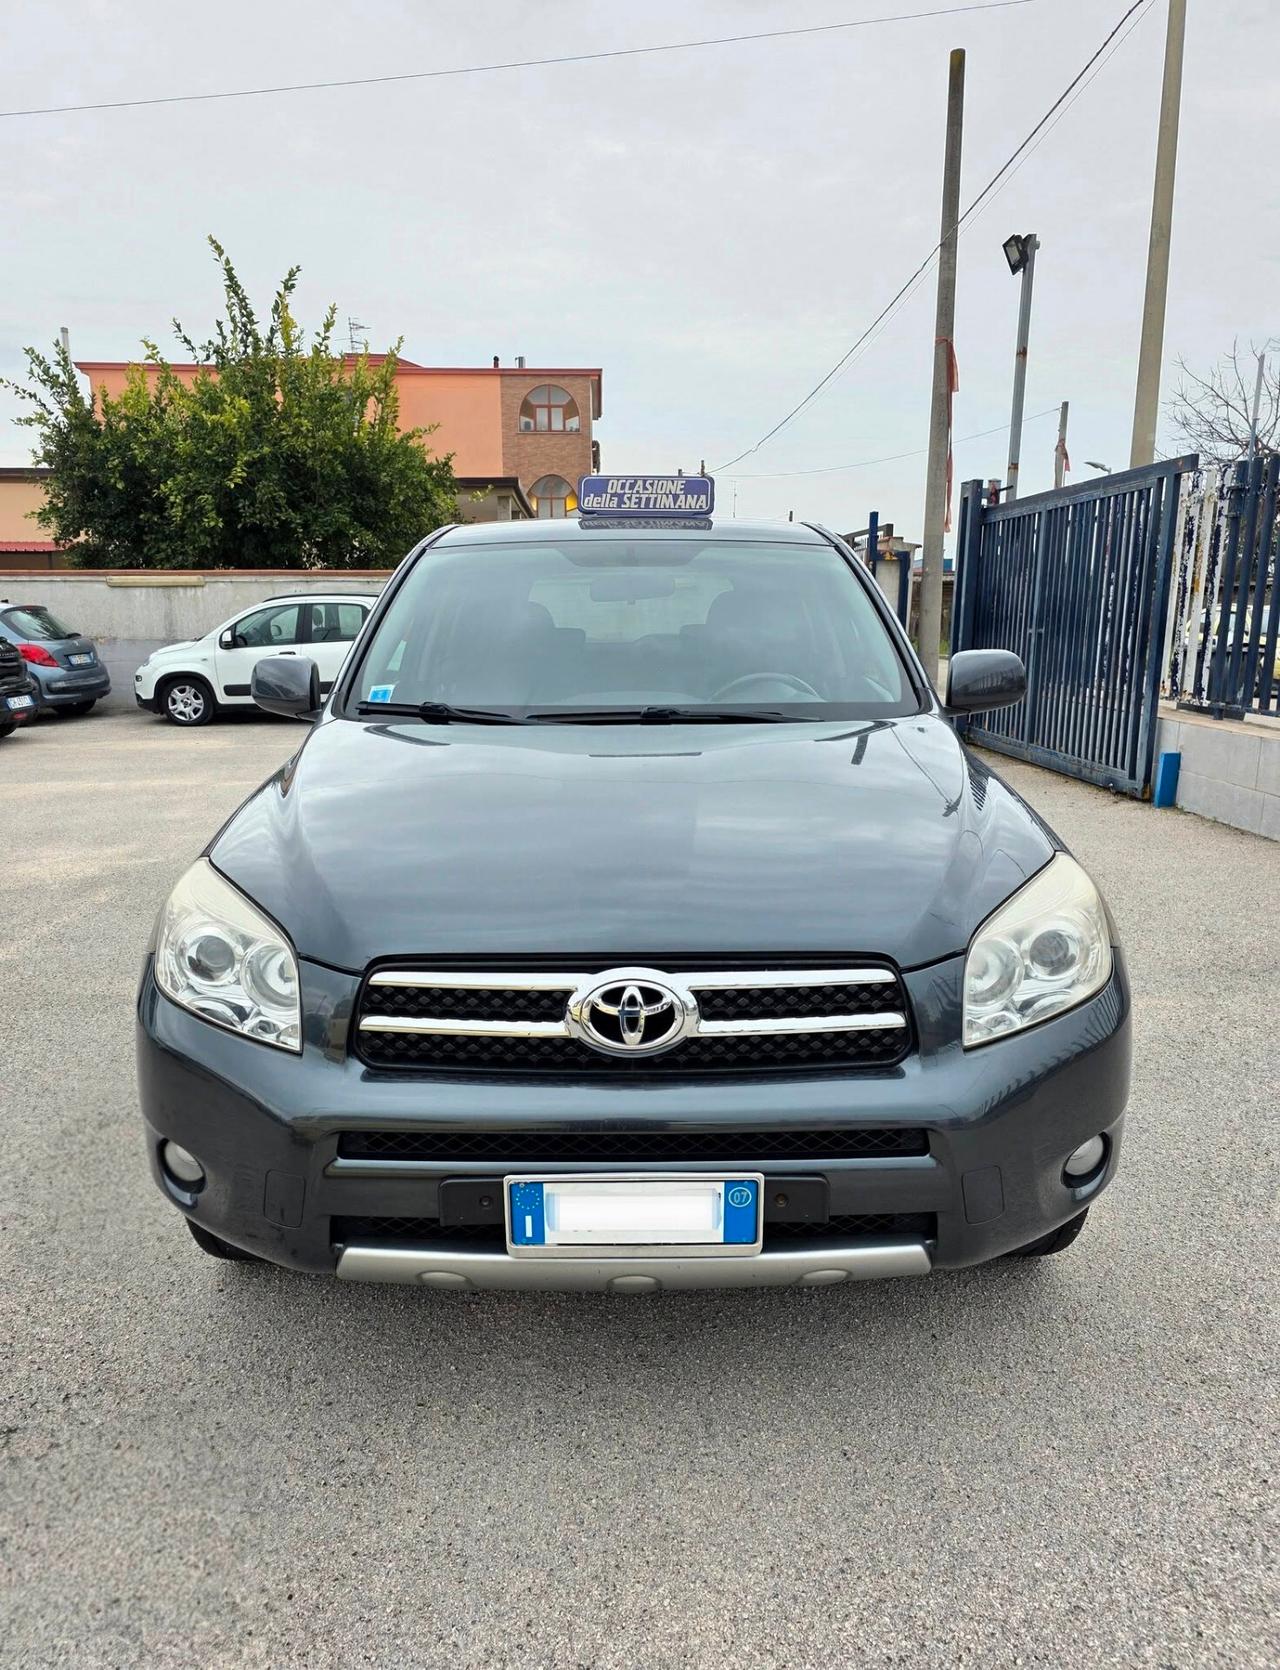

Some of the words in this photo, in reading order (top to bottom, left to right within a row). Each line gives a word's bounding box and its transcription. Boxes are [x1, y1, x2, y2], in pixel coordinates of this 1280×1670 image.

[607, 479, 686, 494] OCCASIONE
[584, 493, 618, 508] della
[621, 494, 707, 509] SETTIMANA
[733, 1190, 748, 1204] 07
